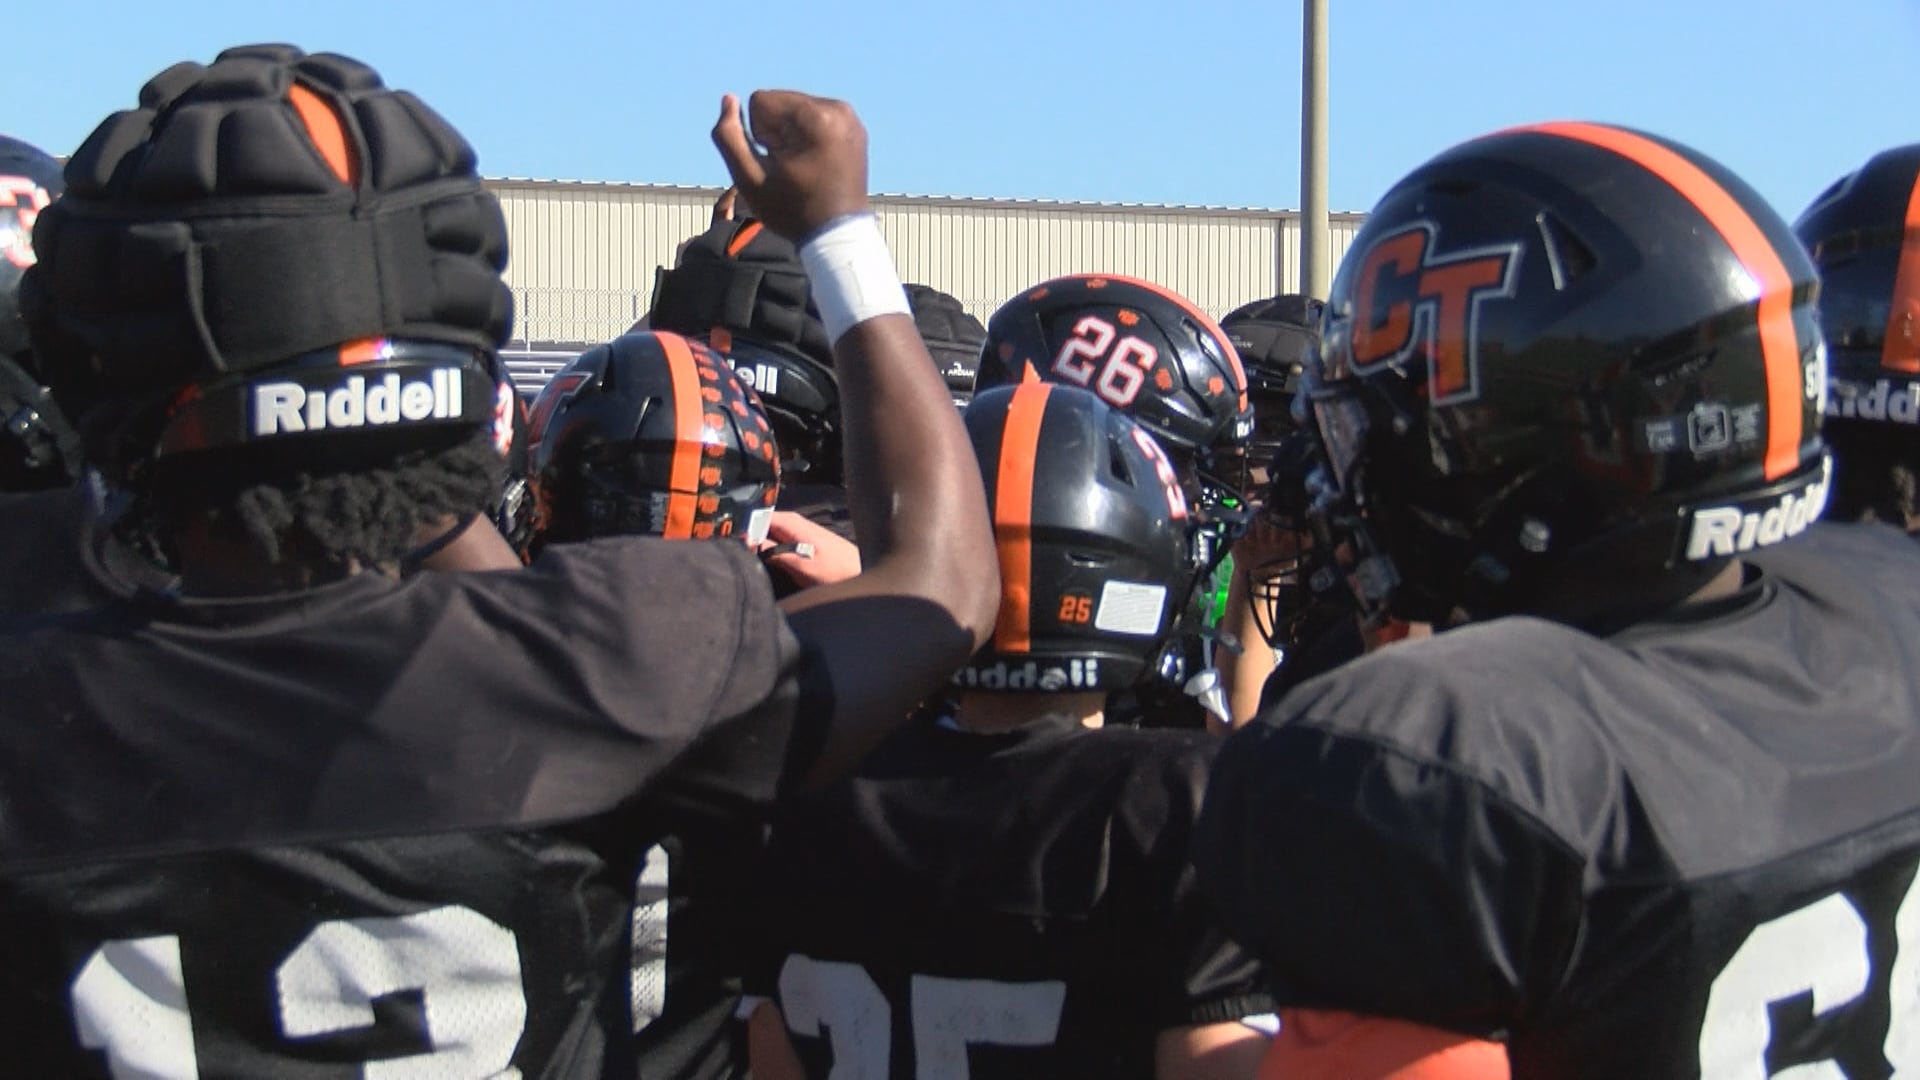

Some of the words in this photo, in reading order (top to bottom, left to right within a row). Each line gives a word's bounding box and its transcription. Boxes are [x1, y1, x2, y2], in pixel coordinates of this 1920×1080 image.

[1347, 220, 1523, 407] CT
[256, 367, 462, 436] Riddell
[1051, 316, 1158, 407] 26
[1058, 594, 1093, 625] 25
[1699, 852, 1920, 1080] 6
